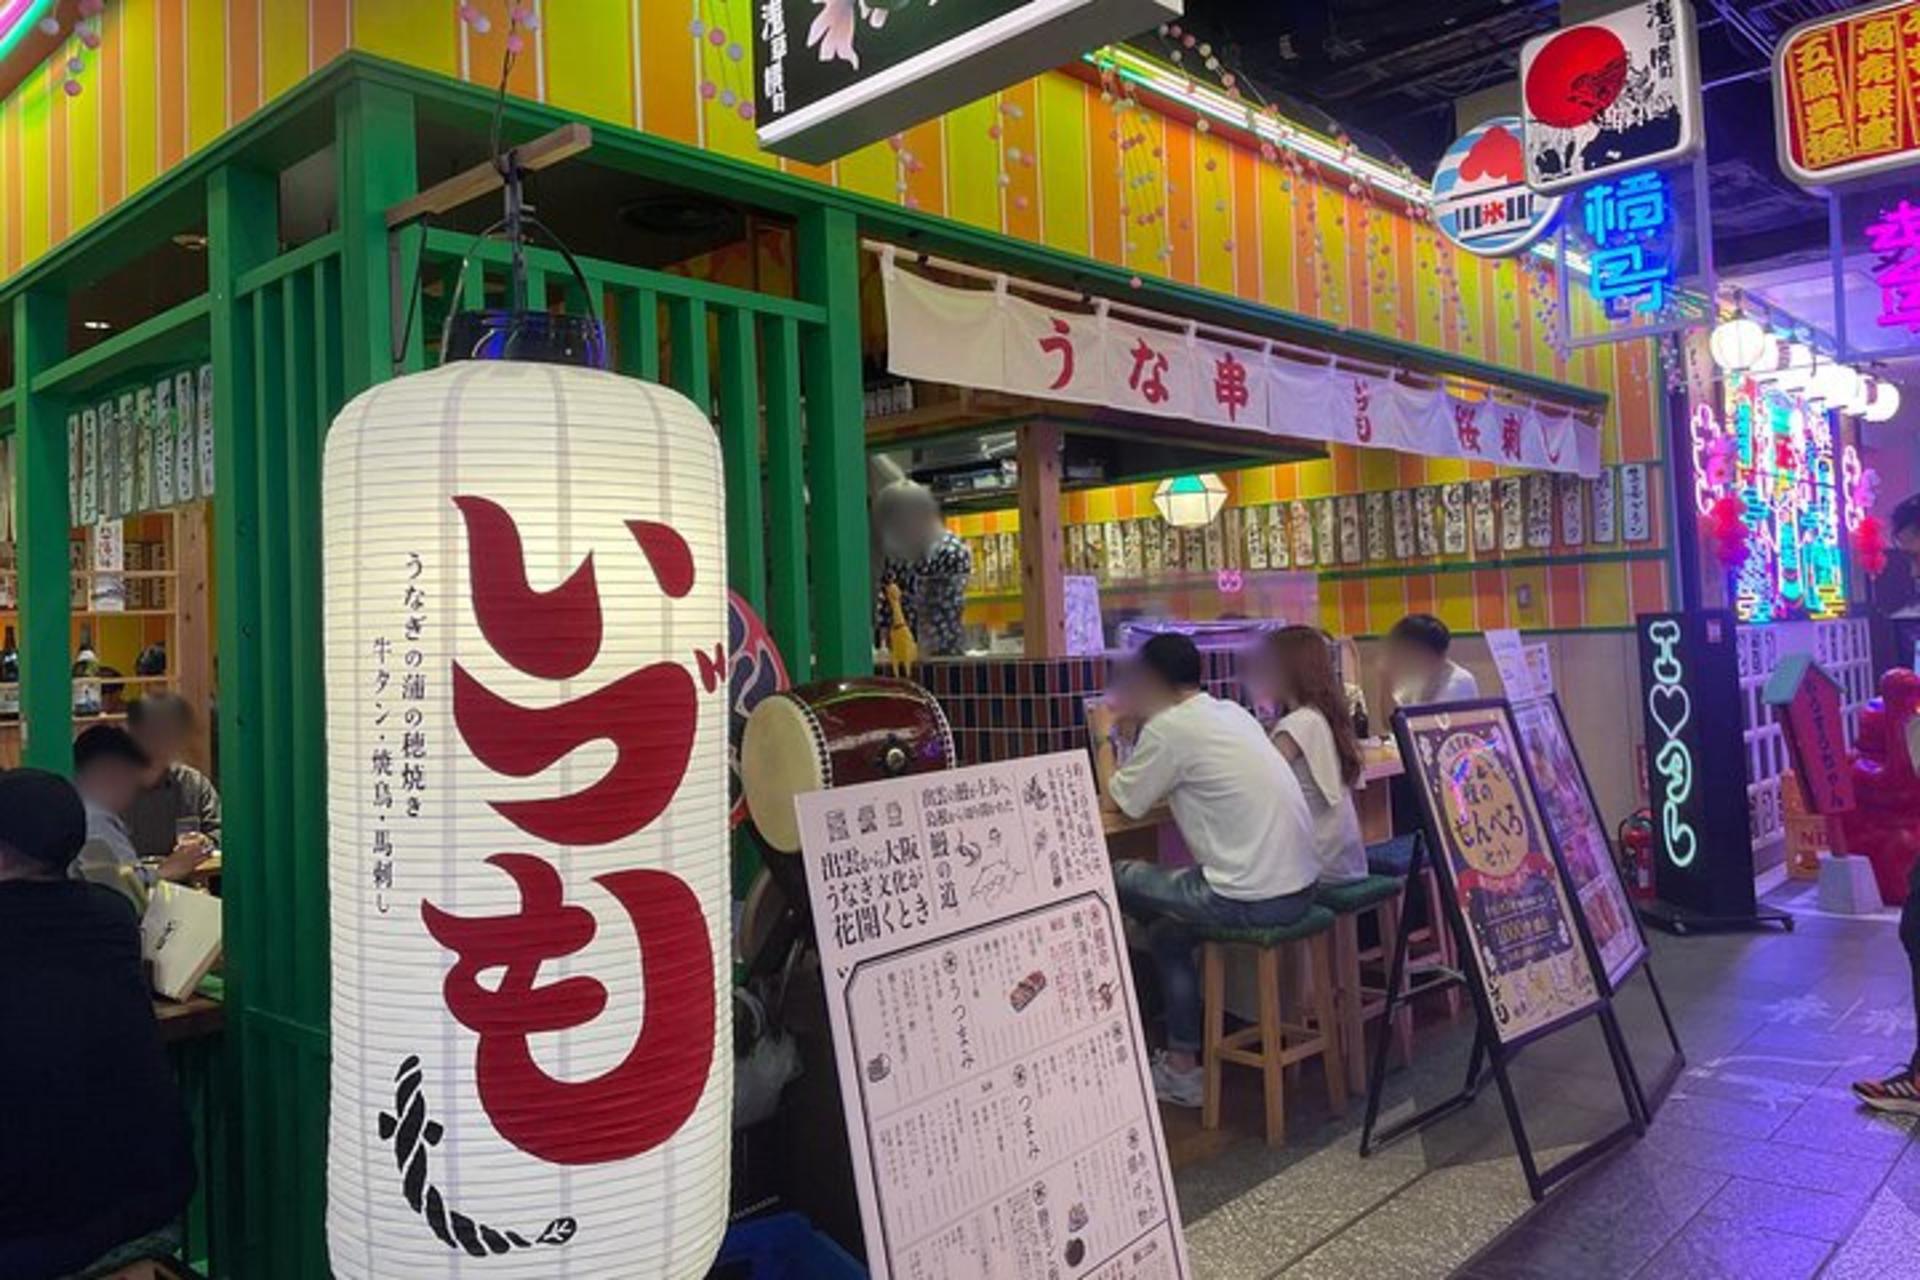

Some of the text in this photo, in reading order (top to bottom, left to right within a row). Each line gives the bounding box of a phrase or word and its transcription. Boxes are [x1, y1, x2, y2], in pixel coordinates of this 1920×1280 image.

[1482, 200, 1505, 225] 氷
[1038, 316, 1249, 423] うな串
[402, 552, 427, 819] うなぎの蒲の穂焼き
[421, 494, 728, 1166] いづも
[825, 865, 926, 914] うなぎ文化が
[832, 894, 931, 950] 花開くとき
